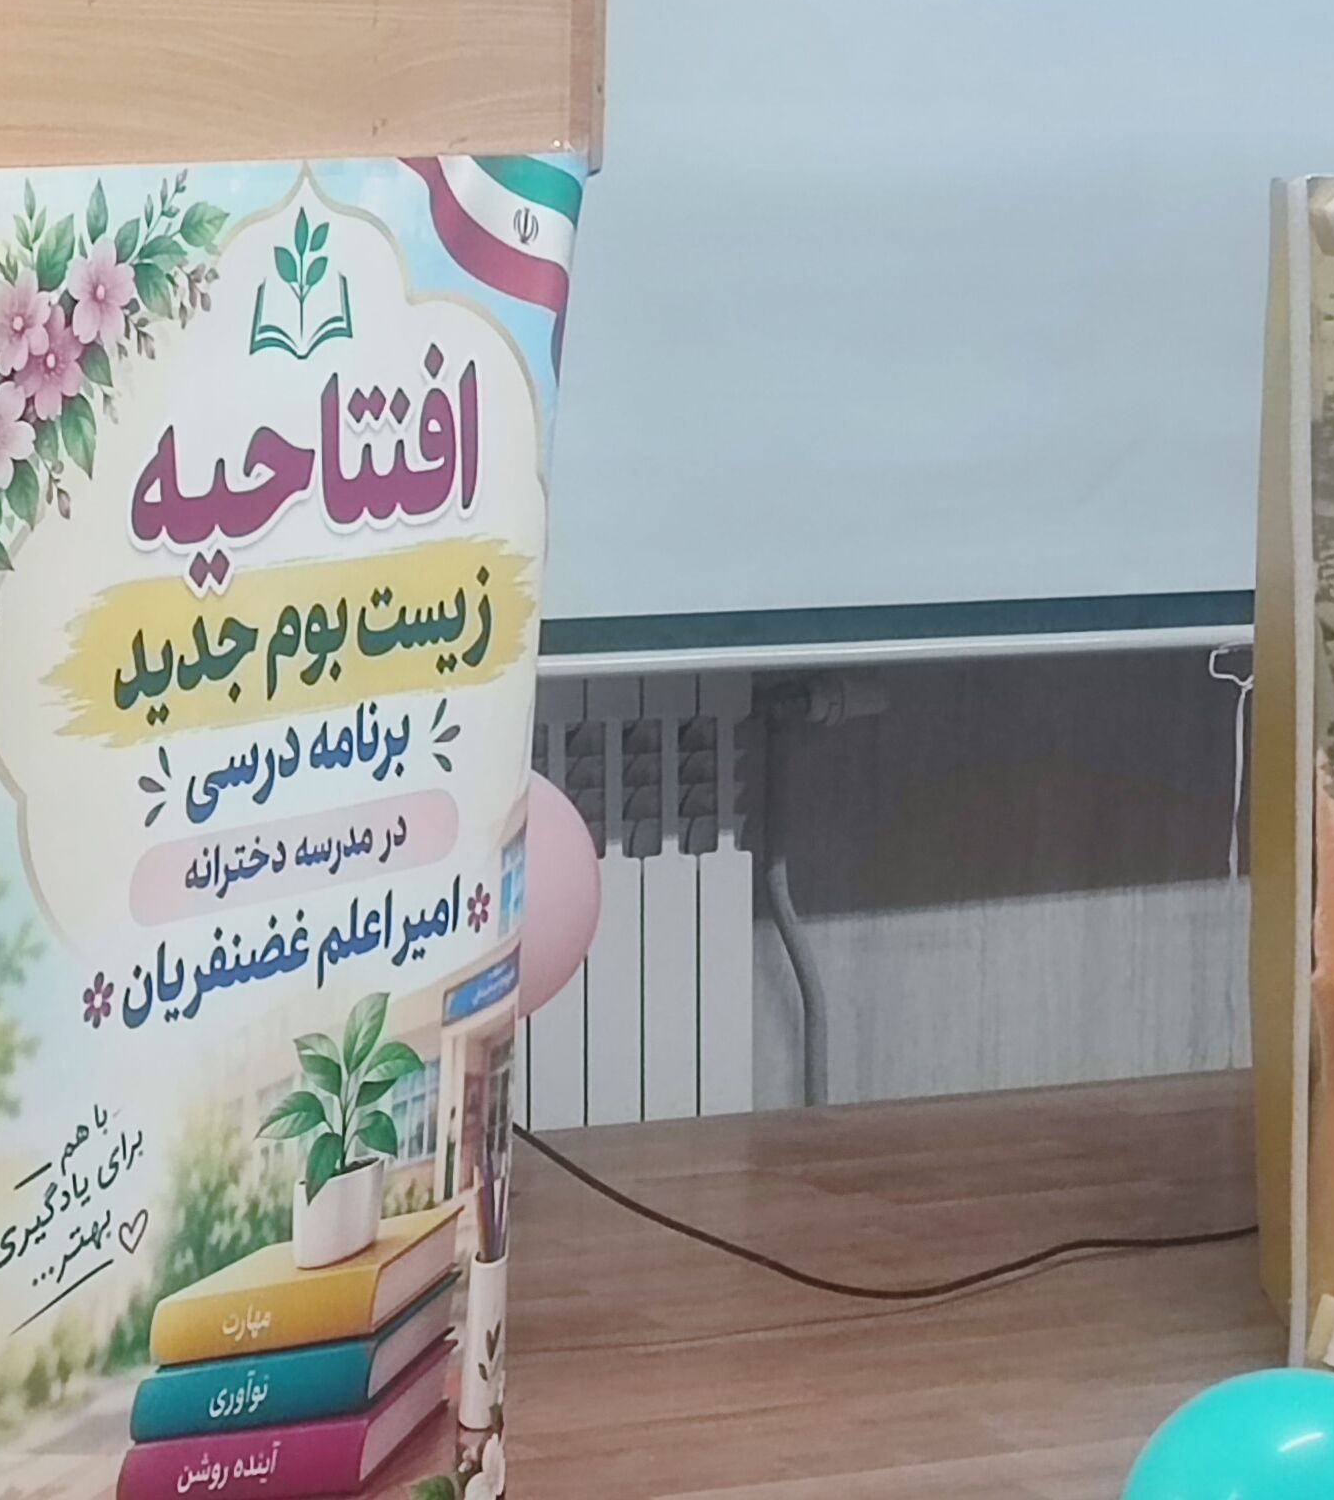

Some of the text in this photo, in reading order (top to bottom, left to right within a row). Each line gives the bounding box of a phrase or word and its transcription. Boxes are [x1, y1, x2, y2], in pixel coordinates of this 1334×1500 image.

[113, 565, 492, 726] زیست بوم جدید
[186, 701, 410, 824] برنامه درسی
[185, 815, 407, 899] در مدرسه دخترانه
[122, 908, 310, 1029] غضنفریان
[61, 1104, 108, 1177] با هم
[97, 1129, 143, 1190] برای
[208, 1370, 270, 1418] نوآوری
[177, 1441, 281, 1493] آینده روشن
